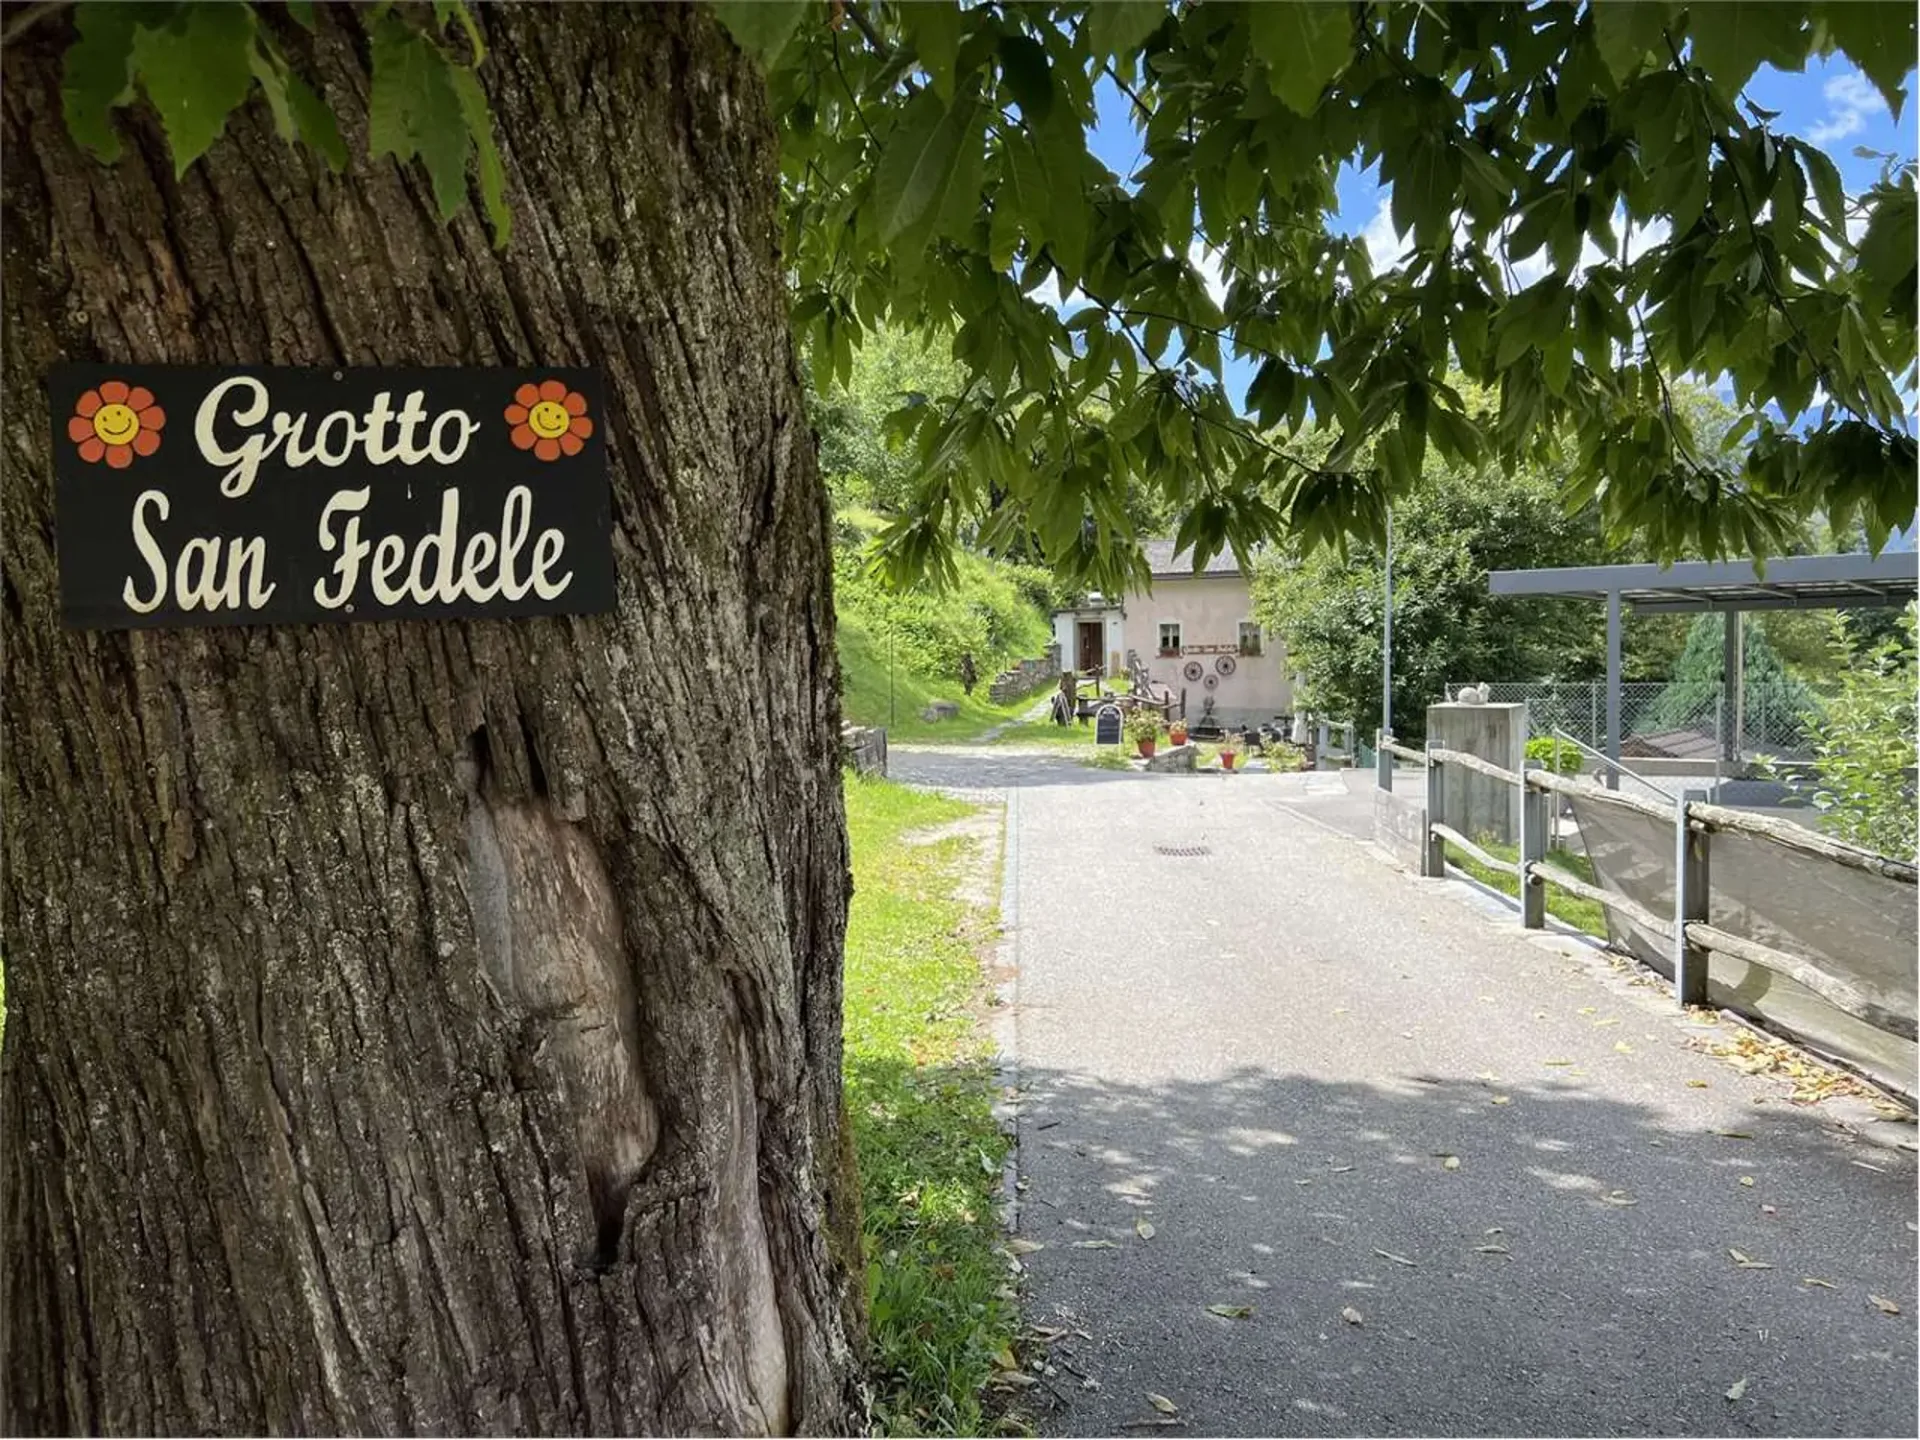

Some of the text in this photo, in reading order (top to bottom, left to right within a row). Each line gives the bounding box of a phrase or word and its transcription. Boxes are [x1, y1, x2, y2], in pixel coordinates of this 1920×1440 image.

[194, 376, 481, 498] Grotto
[122, 485, 574, 613] San Fedele
